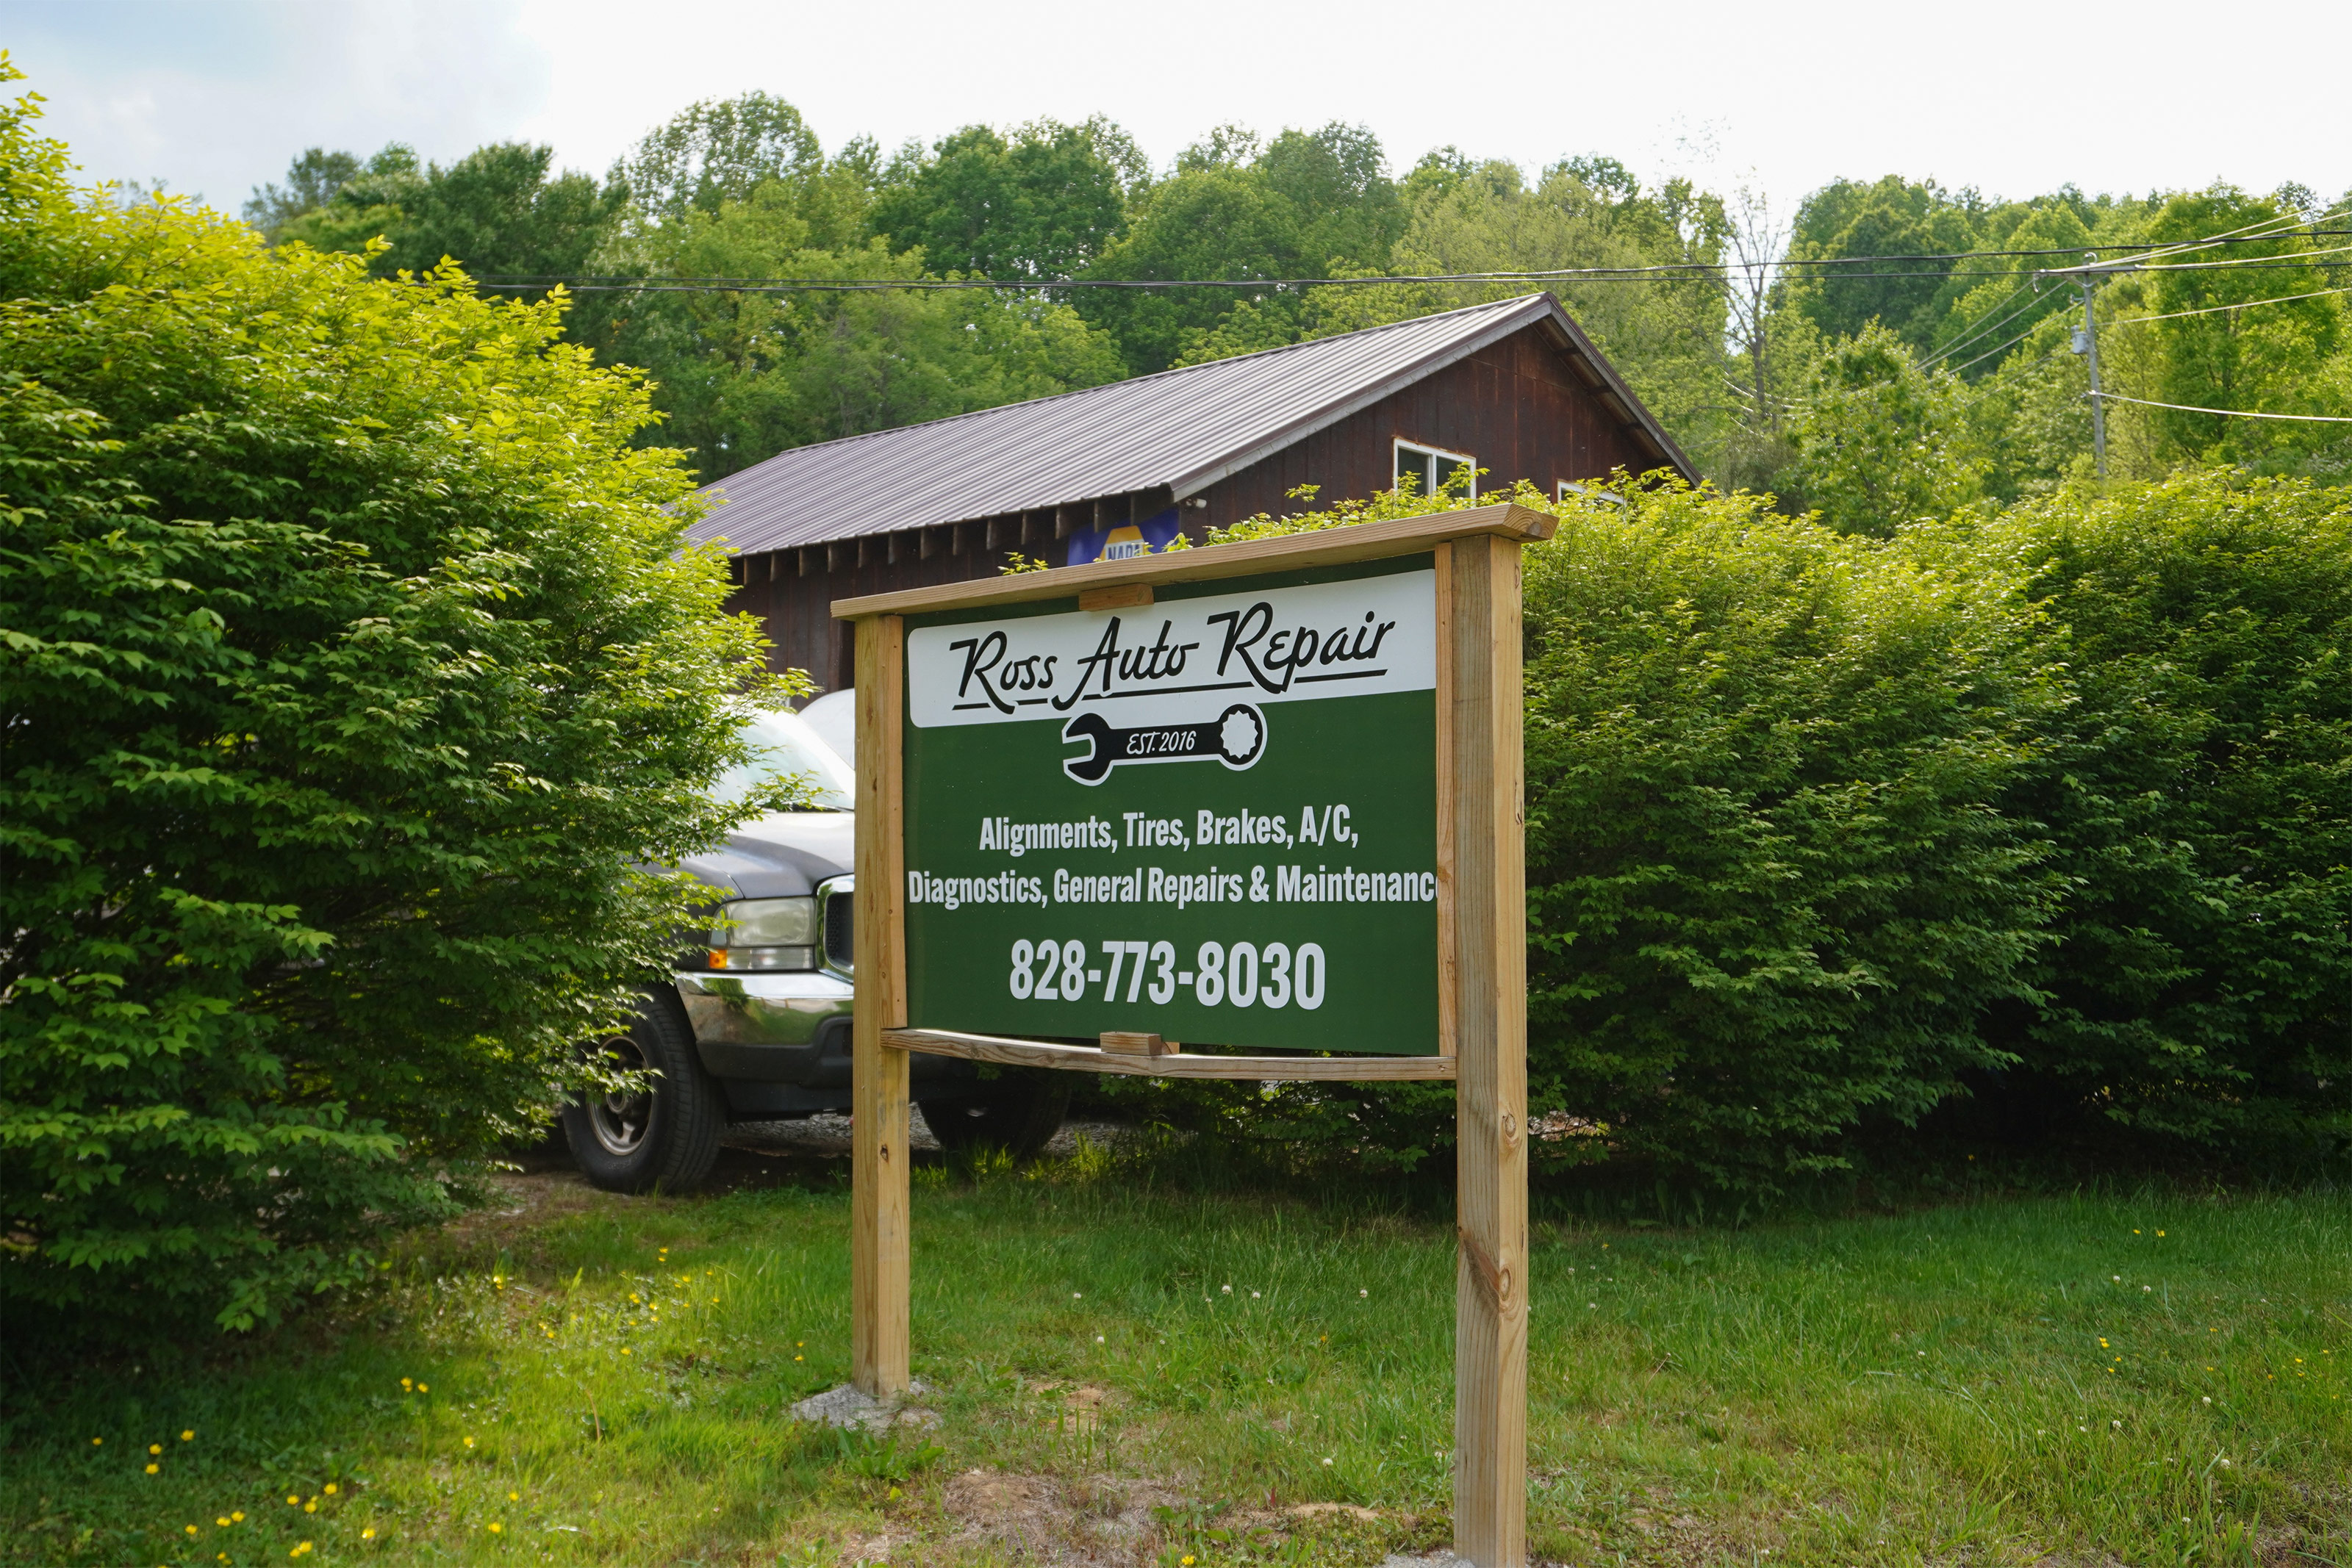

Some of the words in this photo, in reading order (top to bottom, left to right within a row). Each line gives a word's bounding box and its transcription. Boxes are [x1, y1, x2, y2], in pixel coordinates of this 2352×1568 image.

[950, 630, 1058, 714] Ross
[1050, 616, 1200, 711] Auto
[1206, 601, 1396, 694] Repair
[1126, 731, 1157, 755] EST.
[1158, 730, 1197, 752] 2016
[979, 815, 1118, 857] Alignments,
[1122, 812, 1190, 852] Tires,
[1197, 809, 1294, 850] Brakes,
[1299, 804, 1358, 849] A/C,
[908, 870, 1048, 910] Diagnostics,
[1053, 867, 1142, 904] General
[1147, 866, 1244, 910] Repairs
[1249, 865, 1270, 903] &
[1276, 864, 1438, 904] Maintenanc
[1009, 939, 1325, 1010] 828-773-8030
